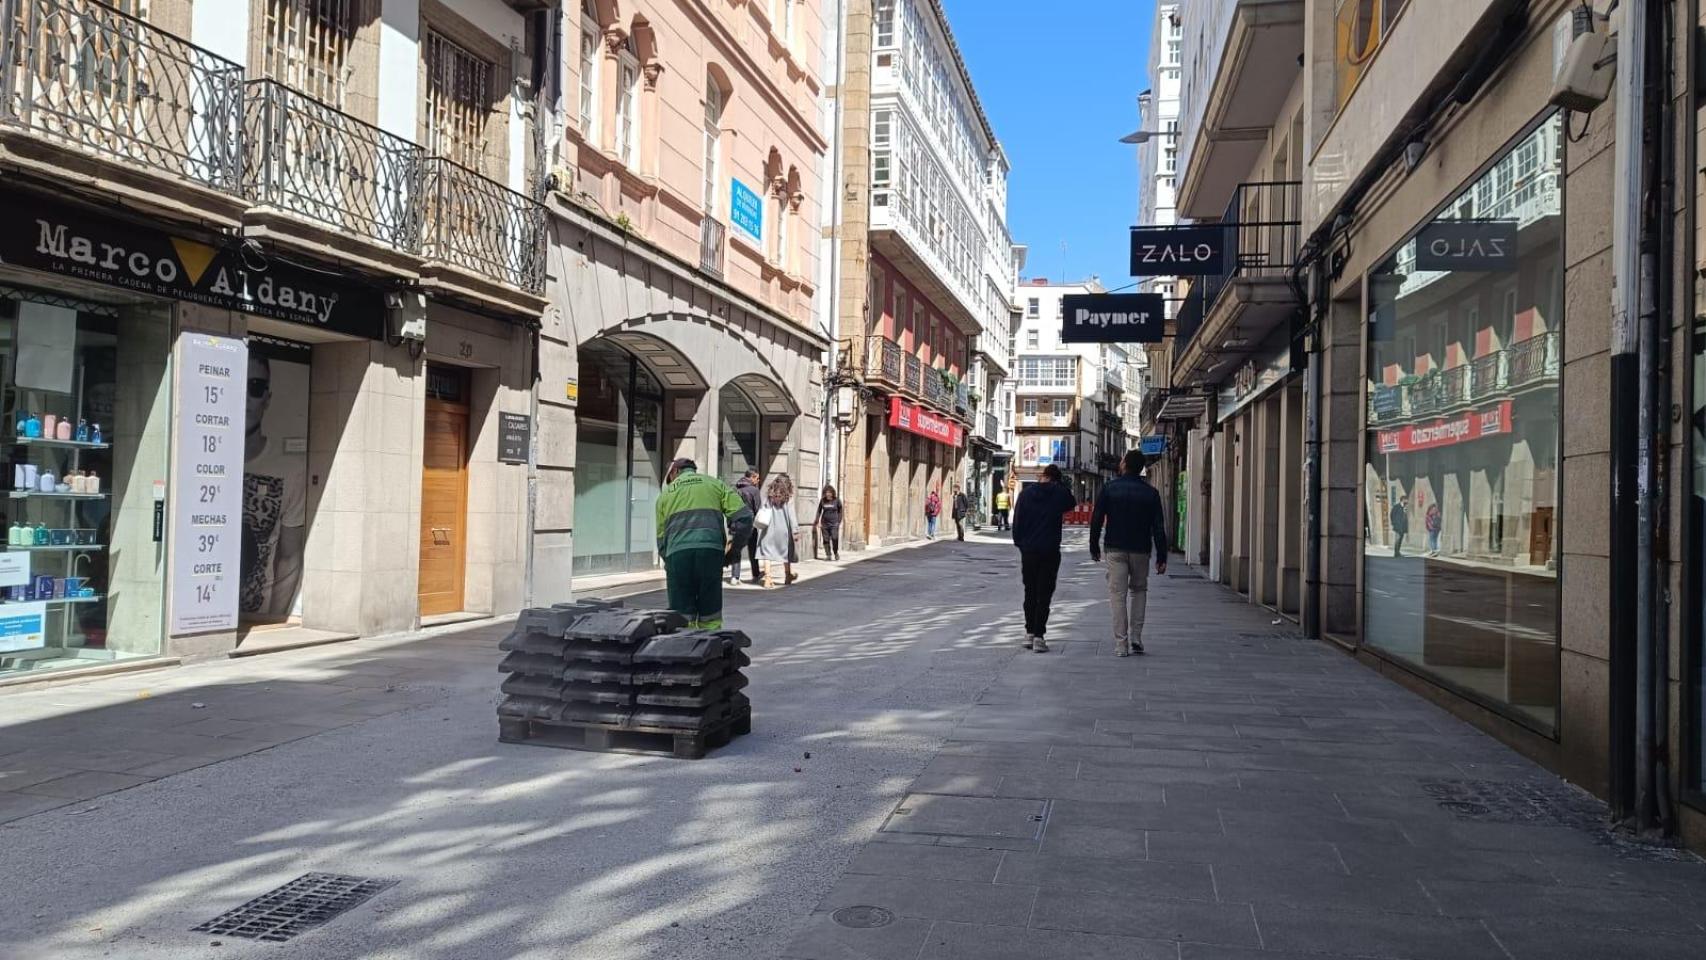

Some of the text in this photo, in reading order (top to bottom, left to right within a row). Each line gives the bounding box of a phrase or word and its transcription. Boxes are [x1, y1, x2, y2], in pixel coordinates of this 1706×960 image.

[1142, 244, 1211, 262] ZALO
[36, 219, 337, 323] Marco Aldany
[52, 261, 65, 271] LA
[71, 265, 113, 281] PRIMERA
[118, 275, 152, 291] CADENA
[157, 284, 169, 293] DE
[1075, 308, 1149, 328] Paymer
[198, 364, 231, 377] PEINAR
[195, 413, 230, 427] CORTAR
[196, 463, 225, 475] COLOR
[191, 514, 227, 525] MECHAS
[193, 563, 222, 574] CORTE
